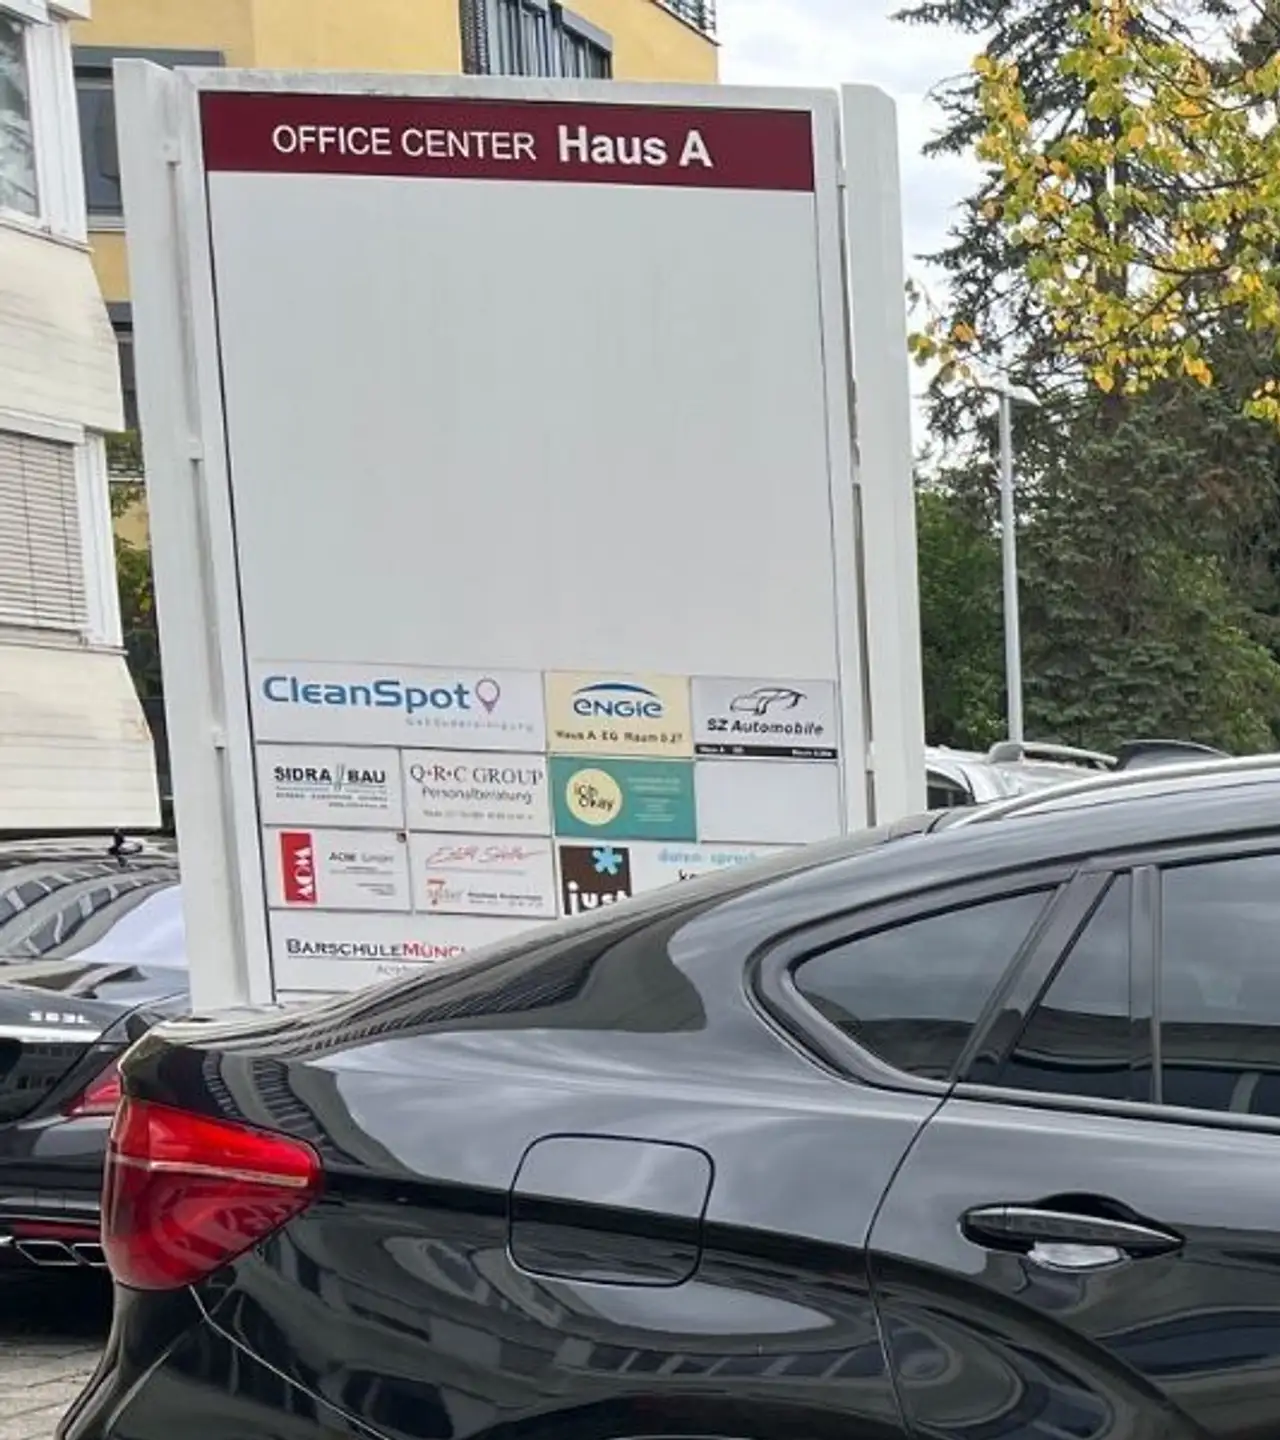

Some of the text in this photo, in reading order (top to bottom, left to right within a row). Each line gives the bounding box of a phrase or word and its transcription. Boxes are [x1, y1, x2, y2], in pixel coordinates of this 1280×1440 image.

[272, 124, 714, 168] OFFICE CENTER Haus A
[262, 675, 471, 713] CleanSpot
[706, 718, 824, 737] SZ Automobile
[273, 766, 332, 783] SIDRA
[472, 766, 544, 785] GROUP
